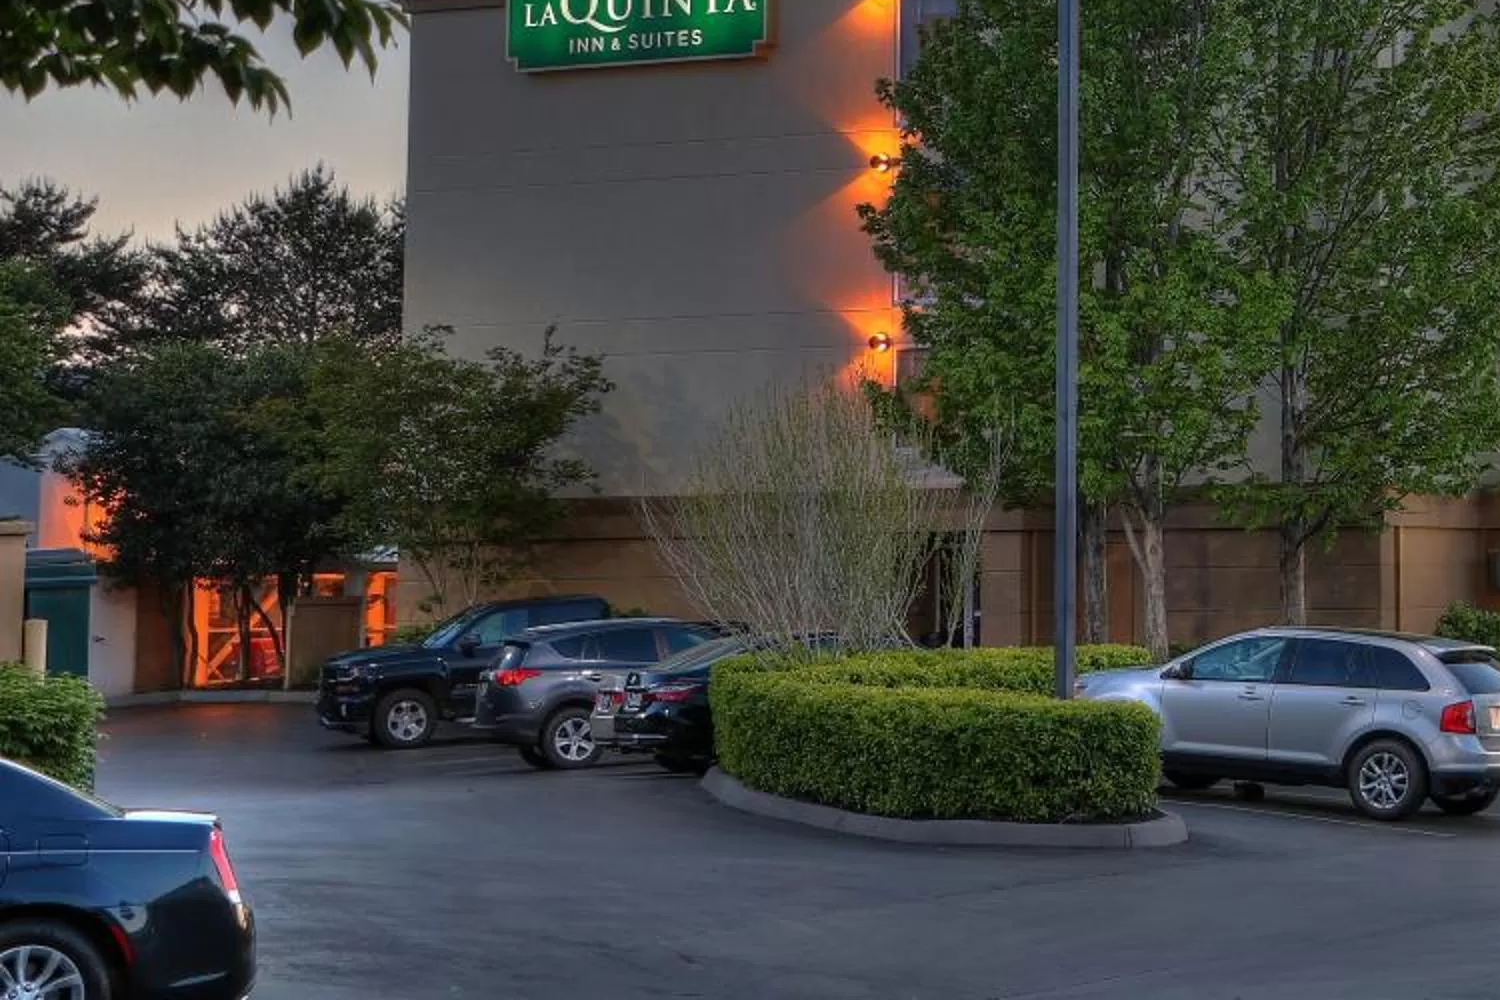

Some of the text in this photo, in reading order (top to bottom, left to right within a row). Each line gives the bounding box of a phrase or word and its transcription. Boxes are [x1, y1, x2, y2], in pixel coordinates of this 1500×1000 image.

[524, 2, 558, 27] LA
[569, 30, 703, 54] INN & SUITES
